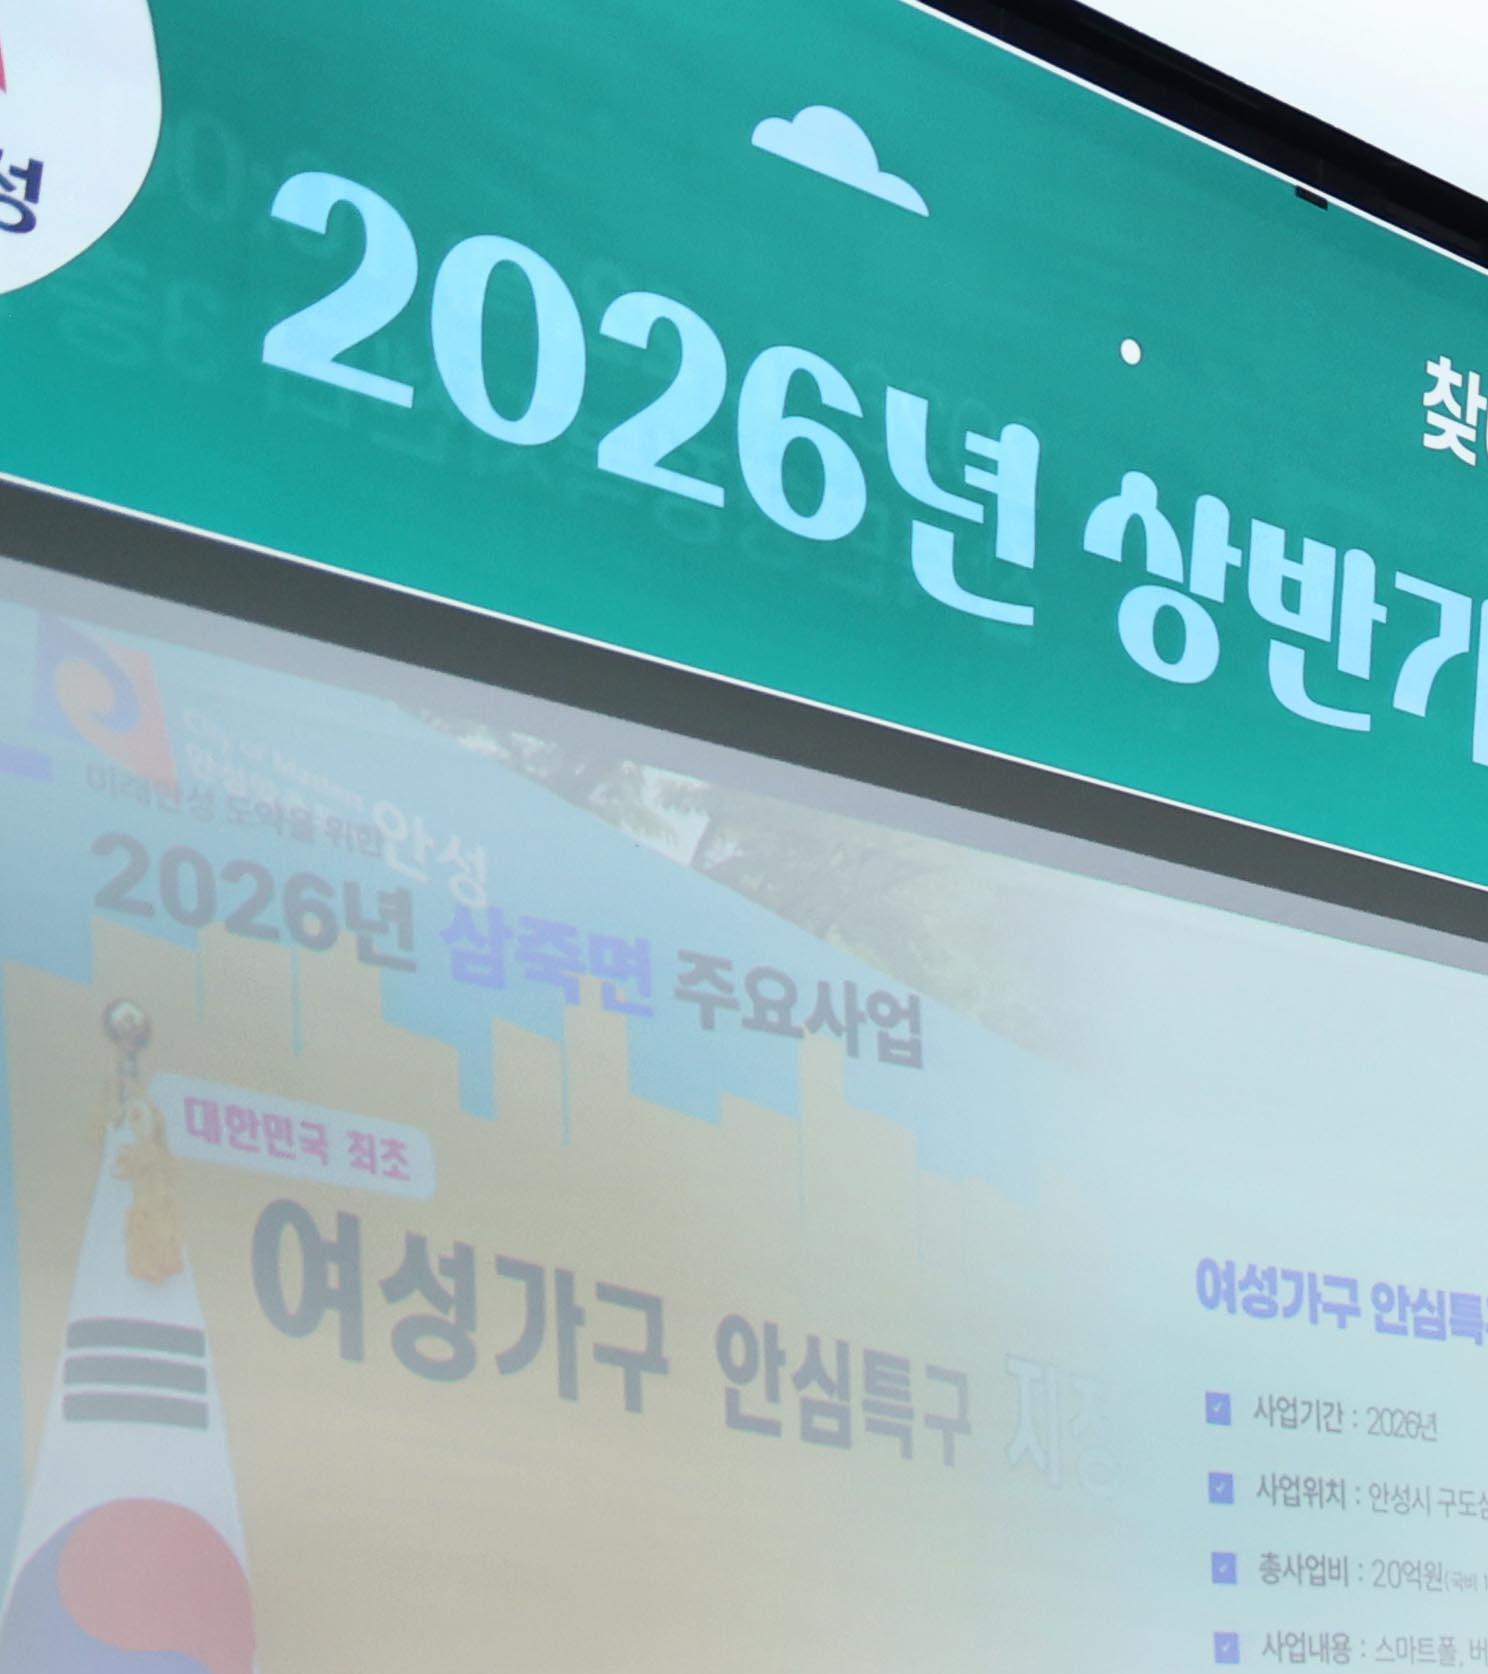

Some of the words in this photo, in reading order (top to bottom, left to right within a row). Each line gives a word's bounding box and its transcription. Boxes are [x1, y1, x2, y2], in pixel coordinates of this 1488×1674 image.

[262, 171, 1041, 627] 2026년
[372, 800, 488, 909] 안성
[90, 831, 417, 973] 2026년
[439, 903, 655, 1020] 삼죽면
[673, 948, 924, 1070] 주요사업
[182, 1096, 329, 1167] 대한민국
[346, 1129, 412, 1183] 최초
[250, 1197, 671, 1415] 여성가구
[714, 1312, 974, 1468] 안심특구
[1195, 1257, 1362, 1330] 여성가구
[1253, 1394, 1345, 1435] 사업기간
[1366, 1405, 1439, 1443] 2026년
[1256, 1472, 1348, 1511] 사업위치
[1368, 1481, 1433, 1517] 안성시
[1258, 1550, 1351, 1588] 총사업비
[1262, 1629, 1353, 1667] 사업내용
